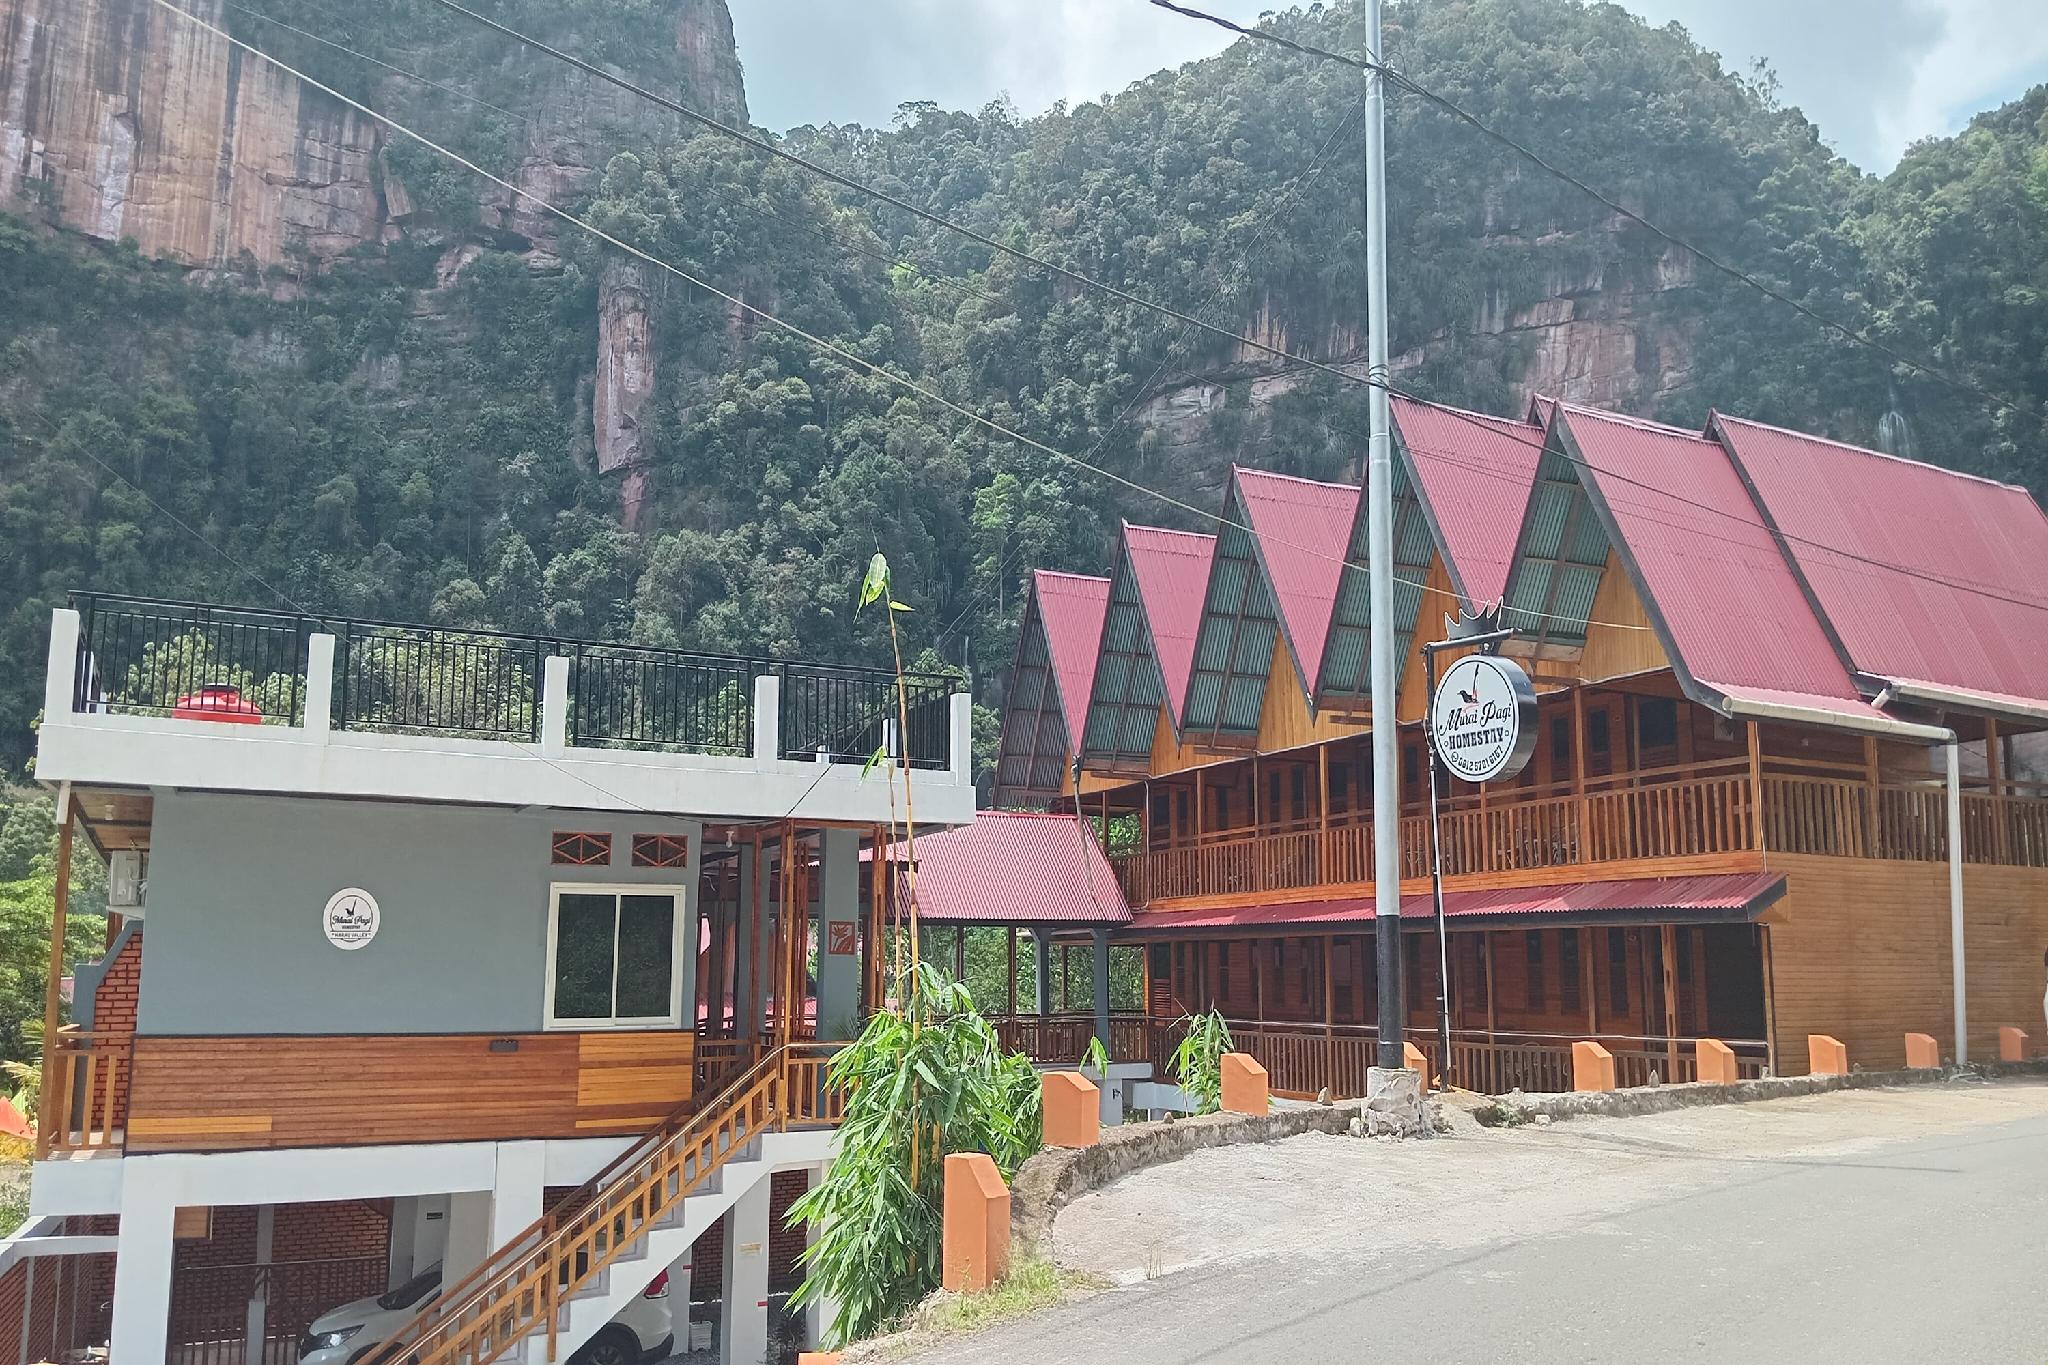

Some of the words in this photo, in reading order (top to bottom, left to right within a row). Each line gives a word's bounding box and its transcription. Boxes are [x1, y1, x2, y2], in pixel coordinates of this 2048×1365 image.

[1439, 707, 1478, 736] Murai
[1480, 700, 1512, 728] Pagi
[1448, 727, 1504, 750] HOMESTAY
